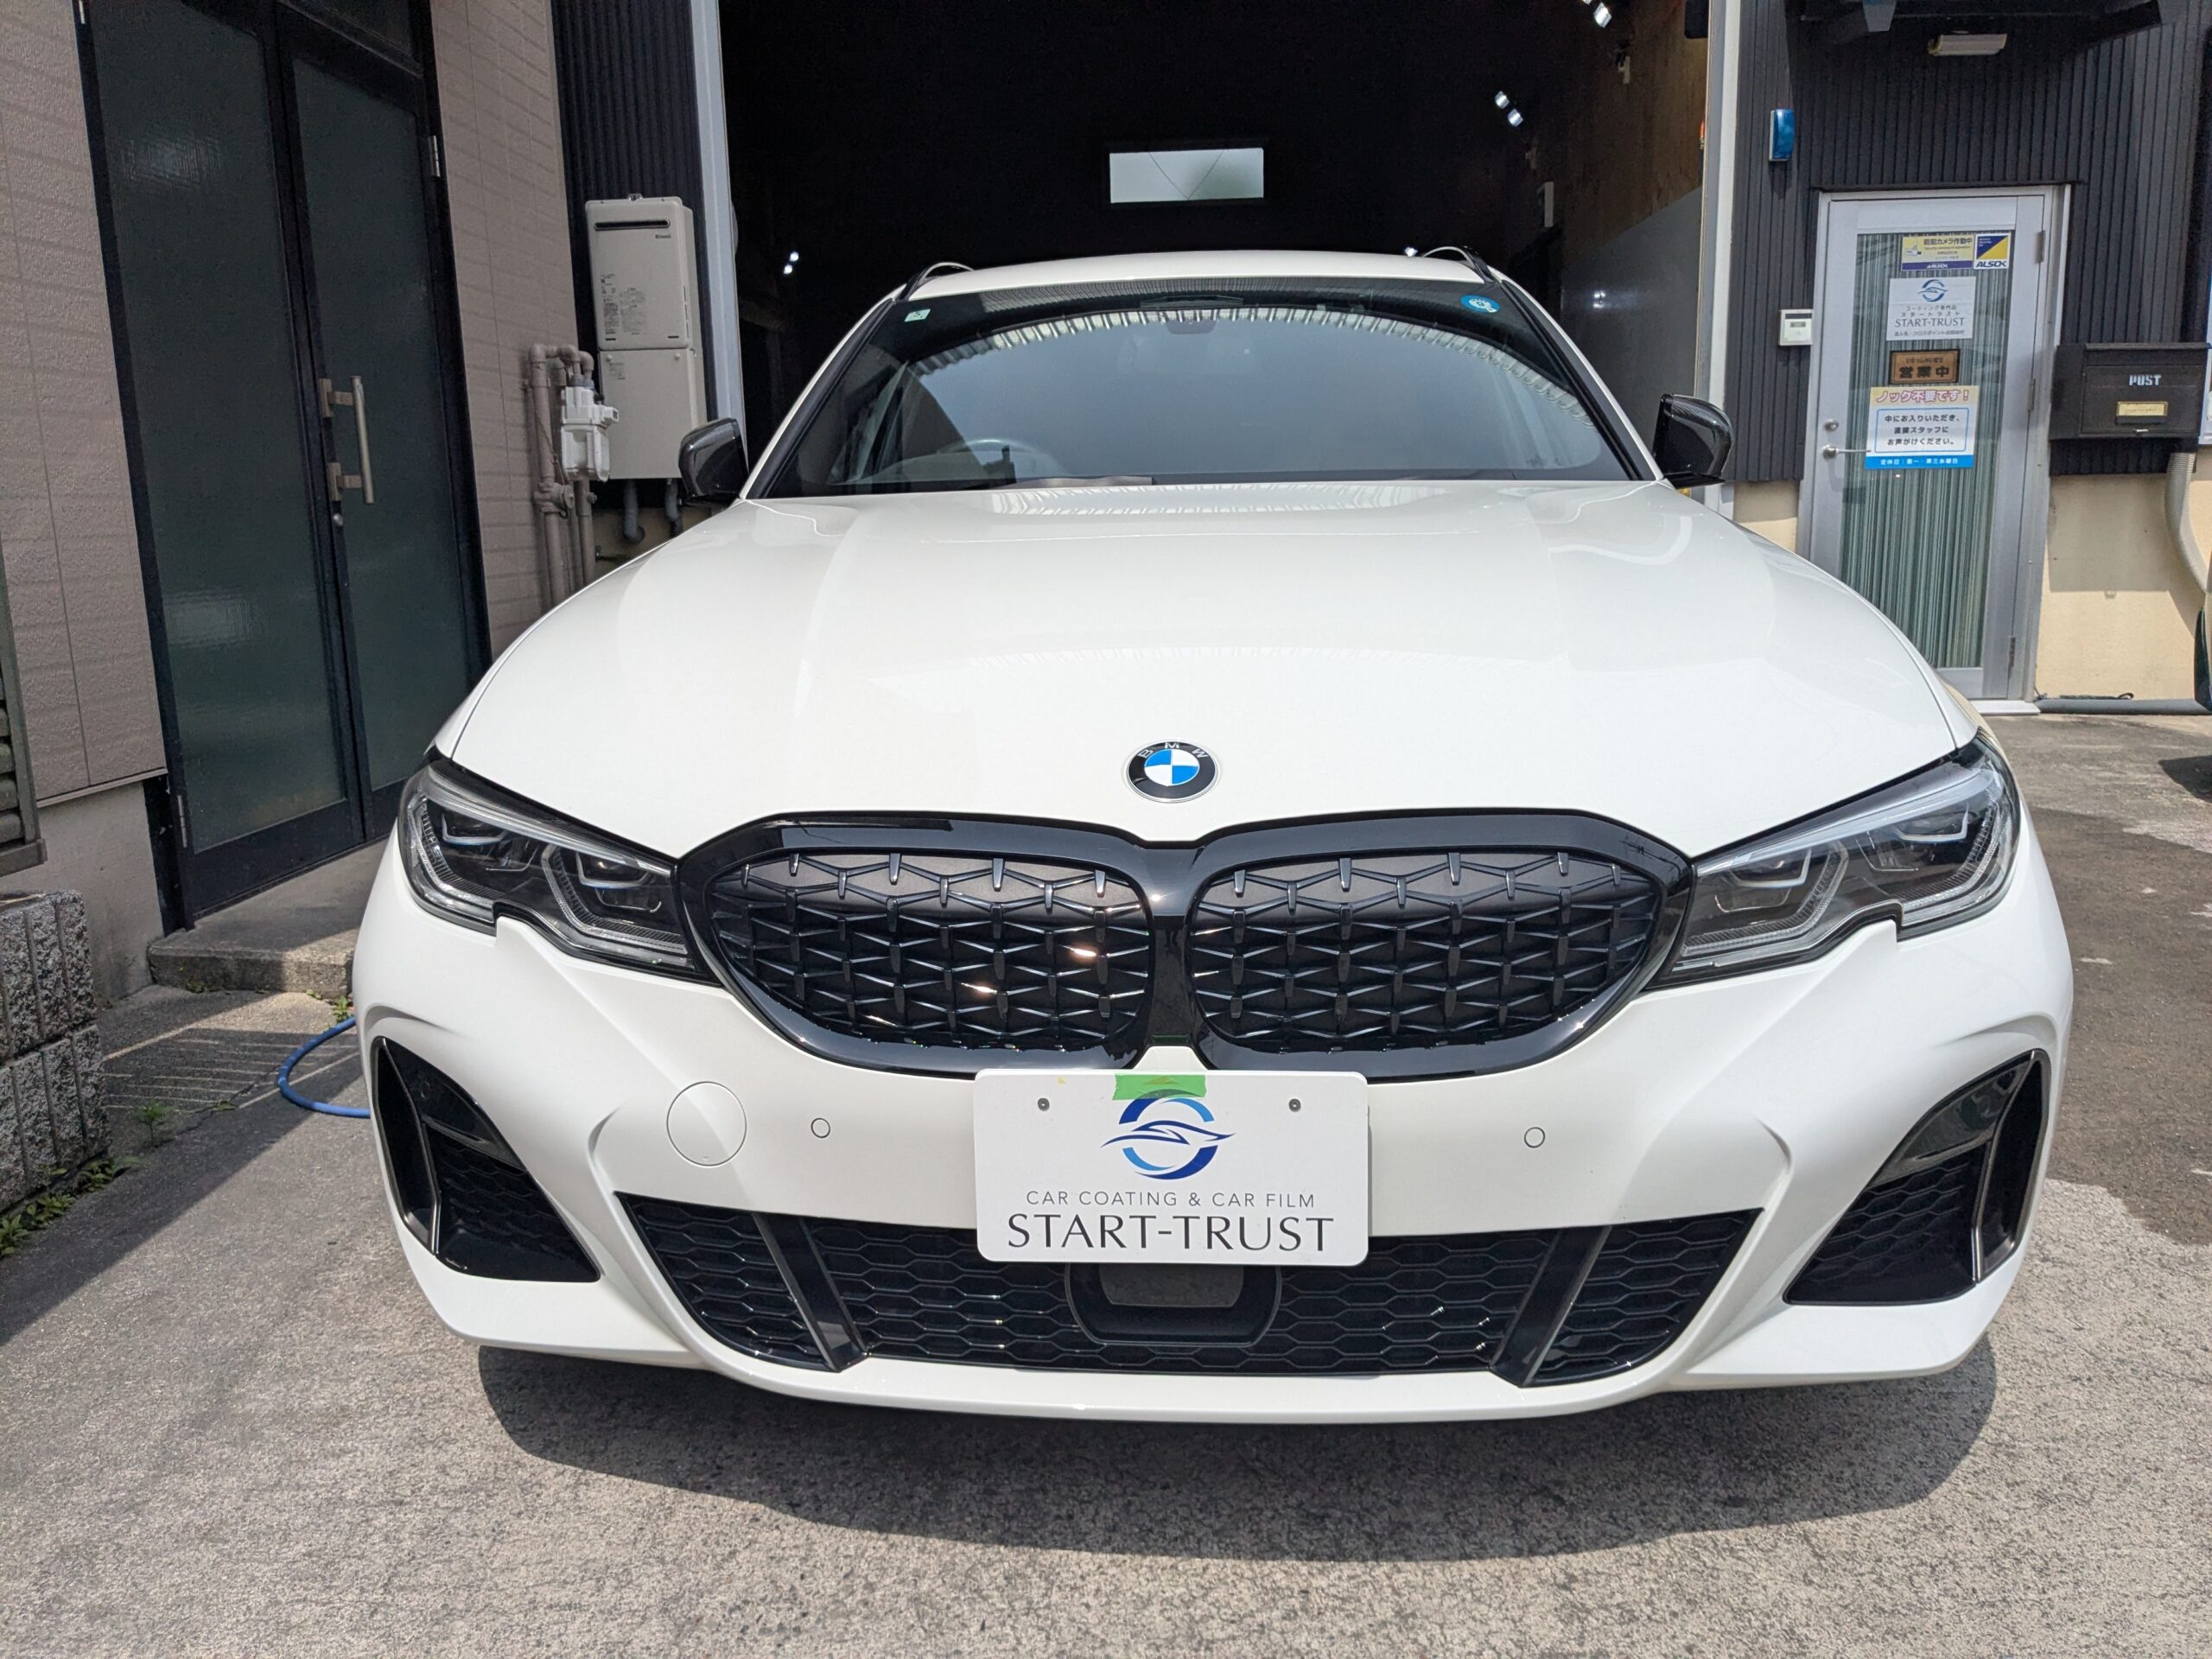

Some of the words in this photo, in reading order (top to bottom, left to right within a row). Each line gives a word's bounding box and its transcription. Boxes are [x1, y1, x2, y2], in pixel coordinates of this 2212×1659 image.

[1894, 317, 1966, 327] START-TRUST
[1898, 365, 1950, 379] 営業中
[2129, 374, 2162, 385] POST
[1885, 414, 1961, 423] 中にお入りいただき、
[1894, 426, 1949, 435] 直接スタッフに
[1137, 741, 1209, 759] BMW
[1026, 1191, 1068, 1206] CAR
[1078, 1191, 1177, 1207] COATING
[1189, 1192, 1202, 1207] &
[1211, 1192, 1255, 1208] CAR
[1266, 1193, 1315, 1209] FILM
[1007, 1212, 1334, 1252] START-TRUST
